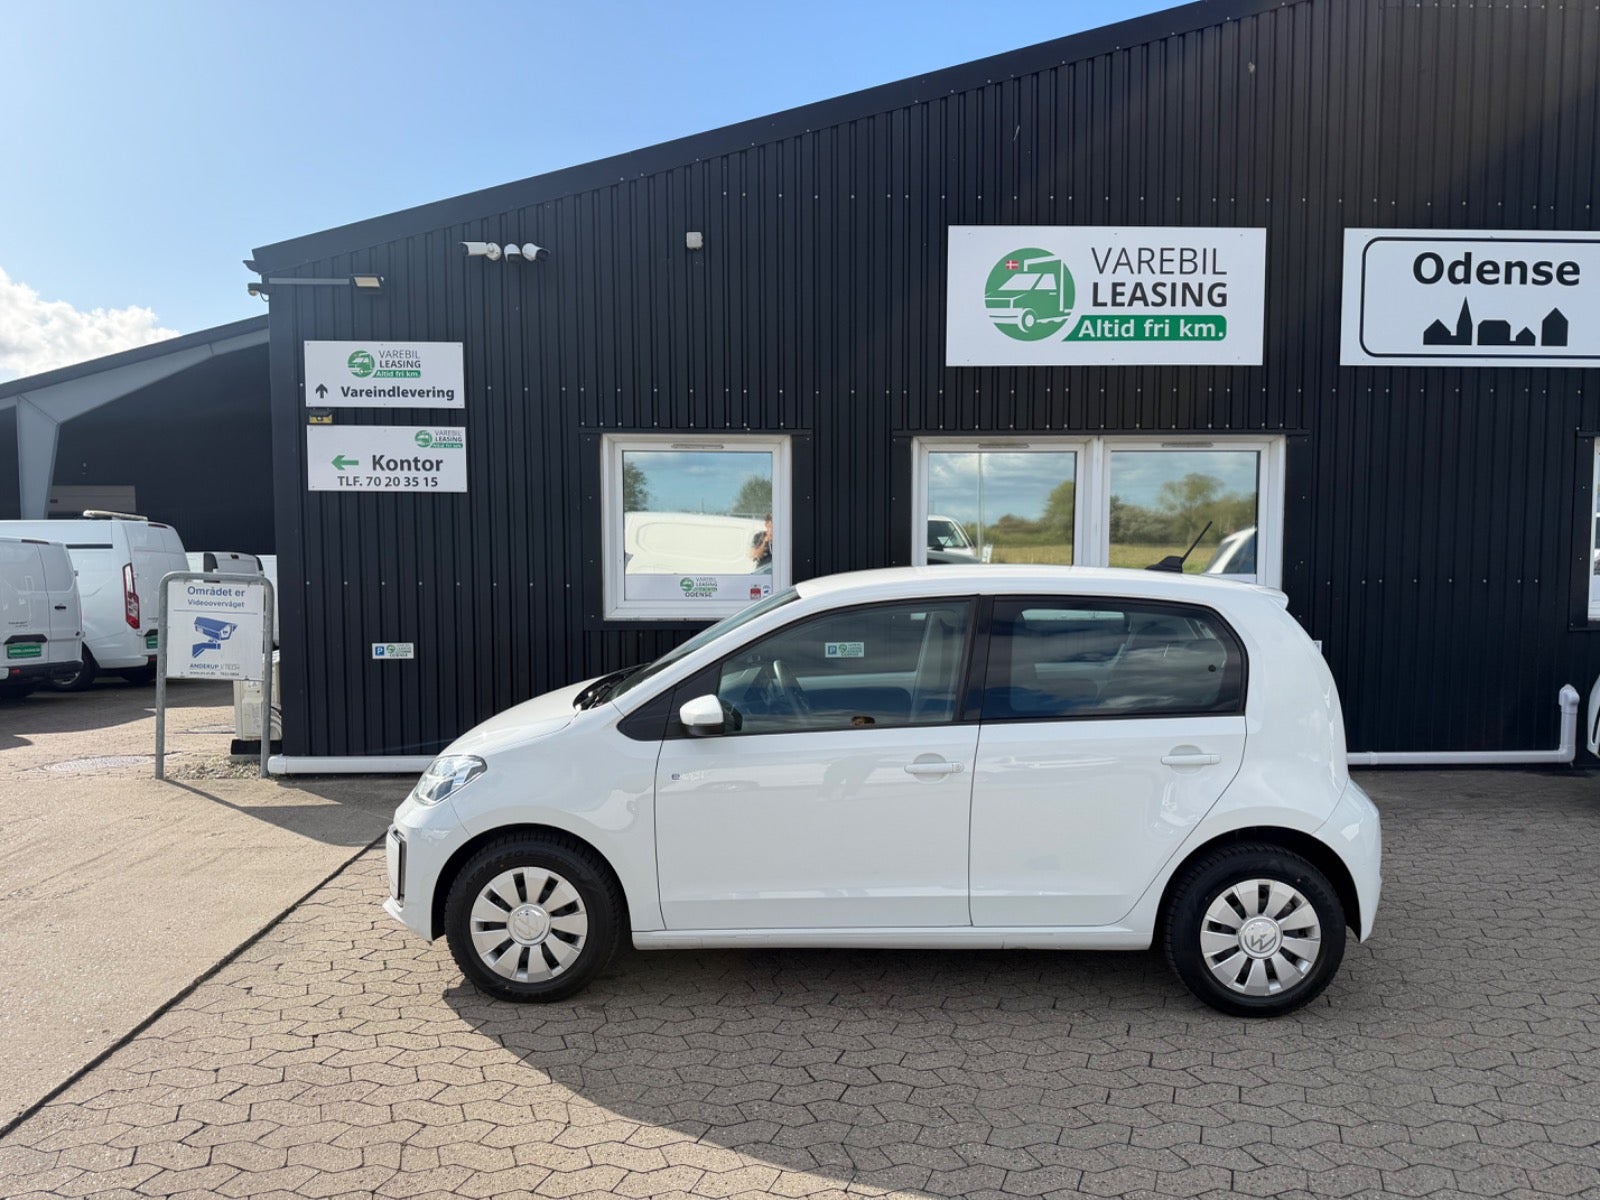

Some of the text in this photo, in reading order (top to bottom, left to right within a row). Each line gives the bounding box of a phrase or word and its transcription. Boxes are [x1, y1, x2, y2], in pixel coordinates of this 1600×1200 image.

[1090, 247, 1228, 275] VAREBIL
[1412, 251, 1581, 286] Odense
[1091, 281, 1228, 308] LEASING
[1077, 318, 1225, 338] Altid fri km.
[378, 350, 421, 359] VAREBIL
[379, 360, 421, 369] LEASING
[340, 385, 455, 401] Vareindlevering
[371, 454, 444, 472] Kontor
[337, 476, 438, 488] TLF. 70 20 35 15
[187, 586, 246, 597] Området er
[187, 599, 245, 608] Videoovervåget
